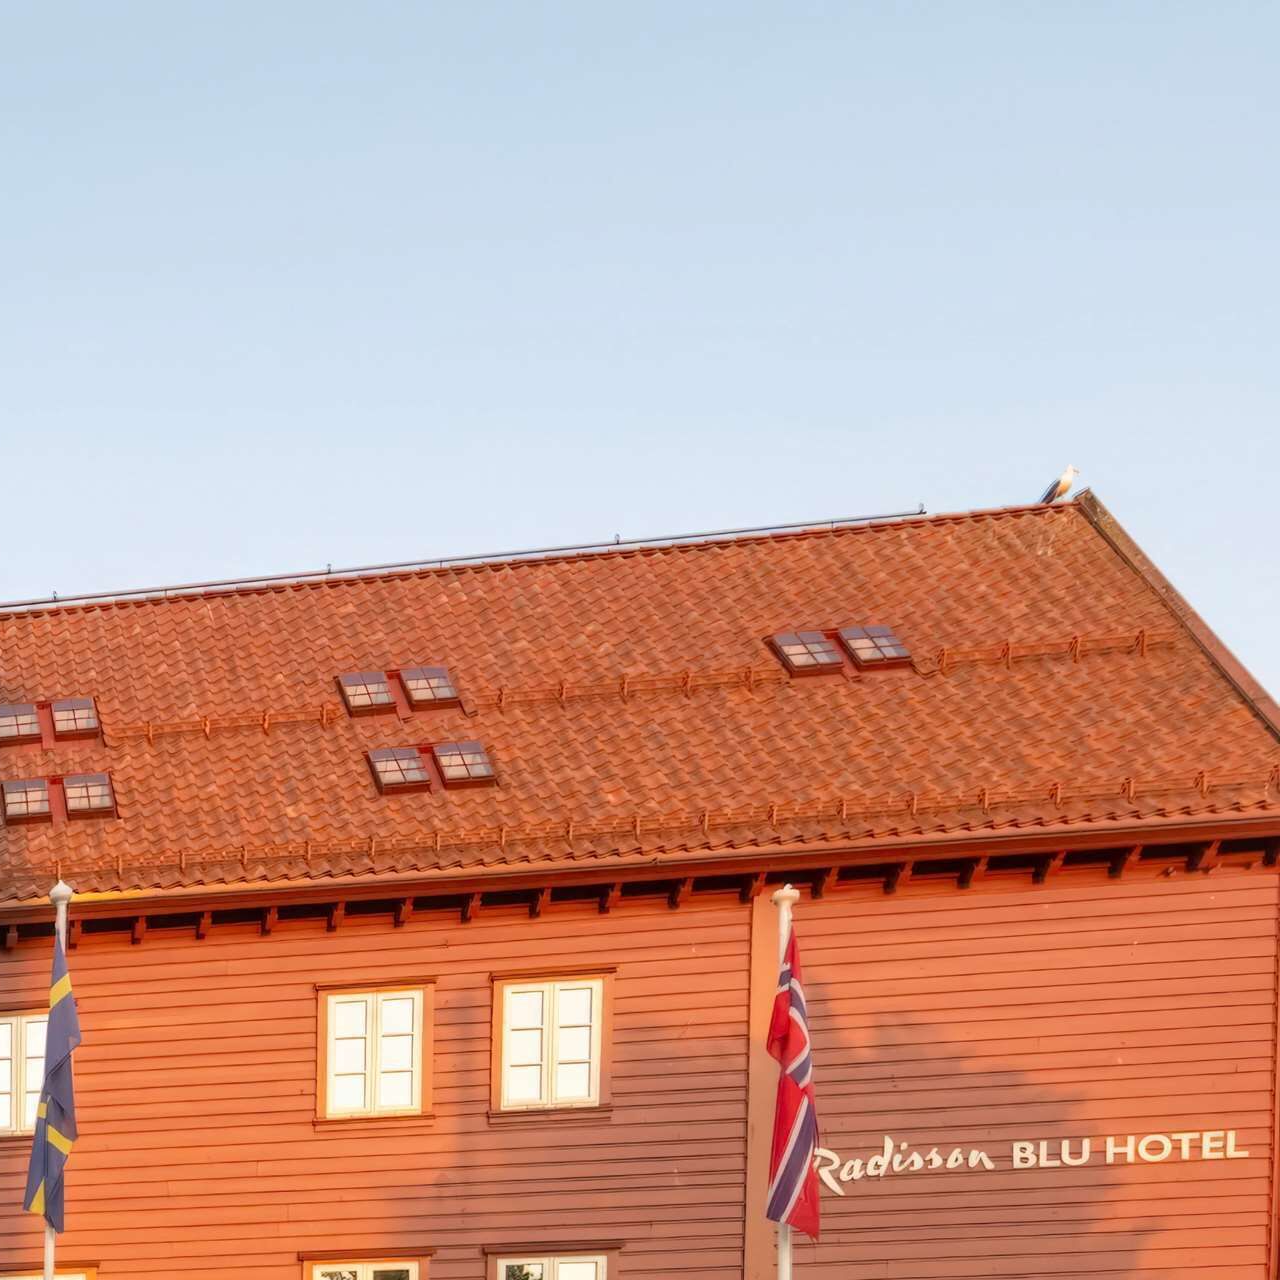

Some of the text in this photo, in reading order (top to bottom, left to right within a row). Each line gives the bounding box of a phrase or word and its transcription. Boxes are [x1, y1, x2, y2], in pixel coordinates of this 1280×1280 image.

[813, 1130, 1249, 1196] Radisson BLU HOTEL
